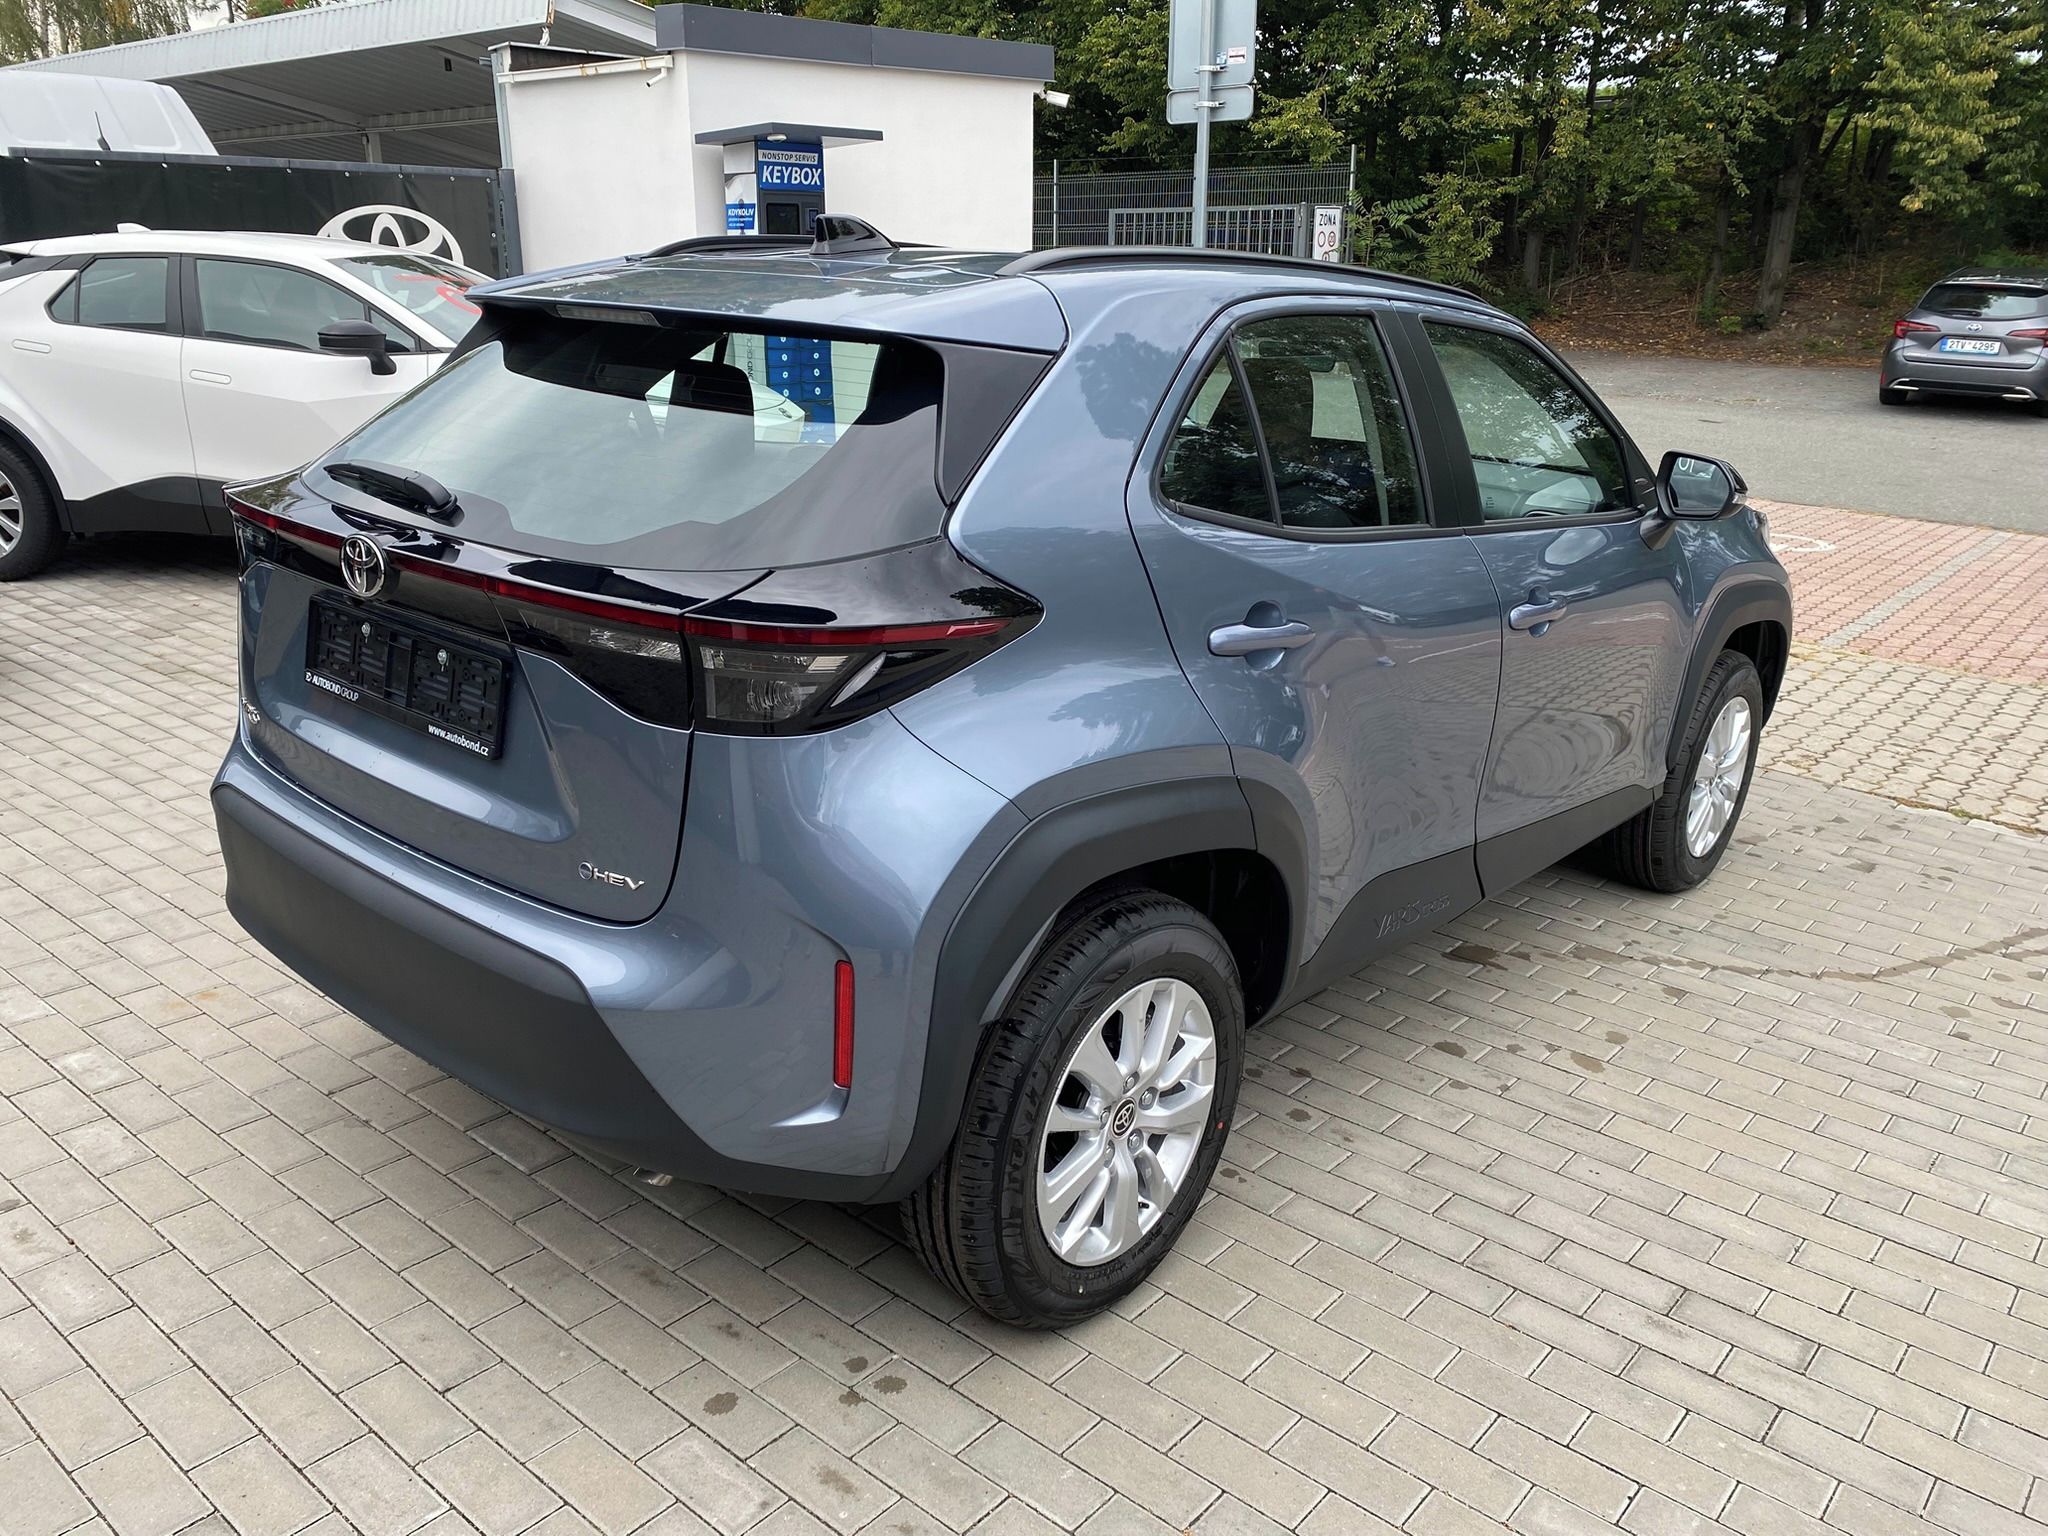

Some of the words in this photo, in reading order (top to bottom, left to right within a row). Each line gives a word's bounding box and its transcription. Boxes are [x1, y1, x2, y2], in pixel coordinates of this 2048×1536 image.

[761, 151, 794, 161] NONSTOP
[794, 154, 817, 163] SERVIS
[762, 165, 822, 186] KEYBOX
[727, 208, 755, 216] KDYKOLIV
[1972, 342, 1996, 351] 4295
[312, 674, 341, 695] AUTOBOND
[341, 687, 359, 702] GROUP
[428, 723, 489, 756] www.autobond.cz
[593, 867, 645, 891] HEV
